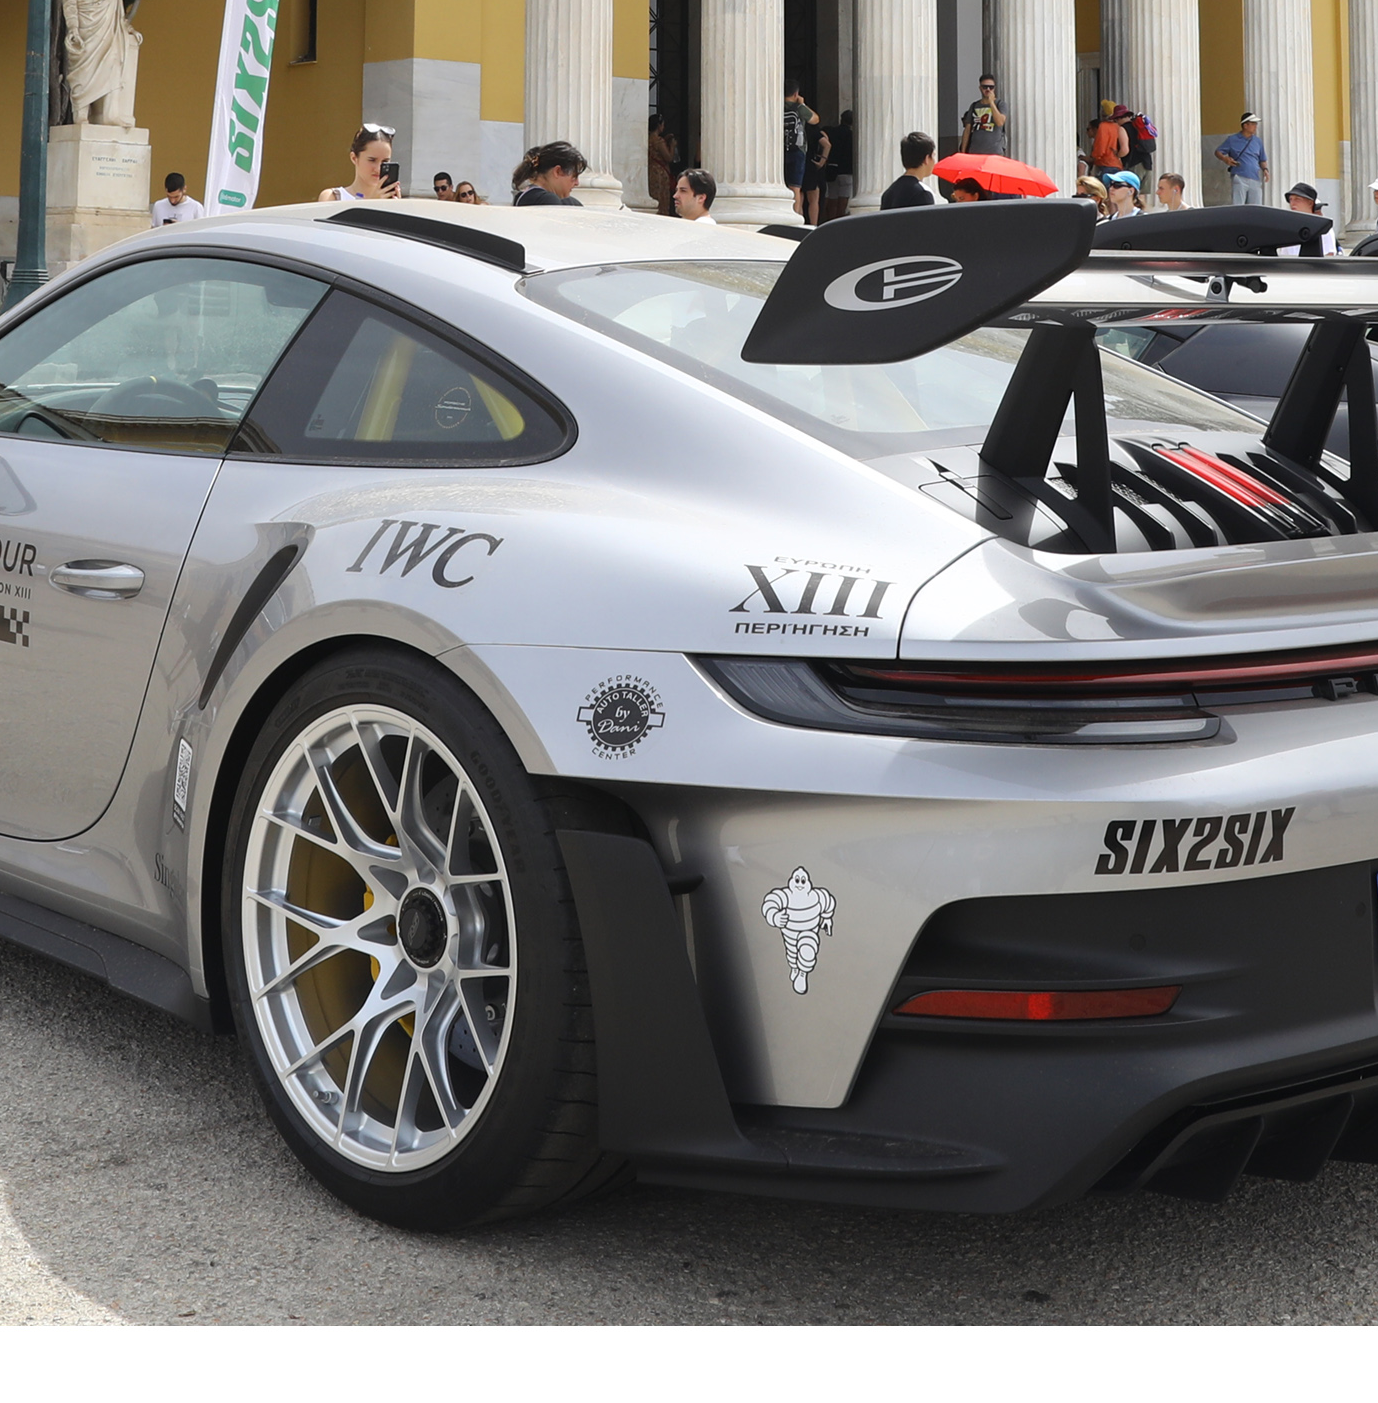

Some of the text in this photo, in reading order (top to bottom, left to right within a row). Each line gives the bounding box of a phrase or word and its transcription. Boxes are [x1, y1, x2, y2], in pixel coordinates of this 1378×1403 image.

[345, 518, 504, 589] IWC
[14, 586, 32, 600] XIII
[728, 564, 897, 619] XIII
[585, 674, 663, 709] PERFORMANCE
[596, 691, 649, 717] AUTO TALLER
[597, 718, 640, 734] Dani
[615, 705, 631, 723] by
[591, 747, 636, 761] CENTER
[1094, 806, 1296, 875] SIX2SIX
